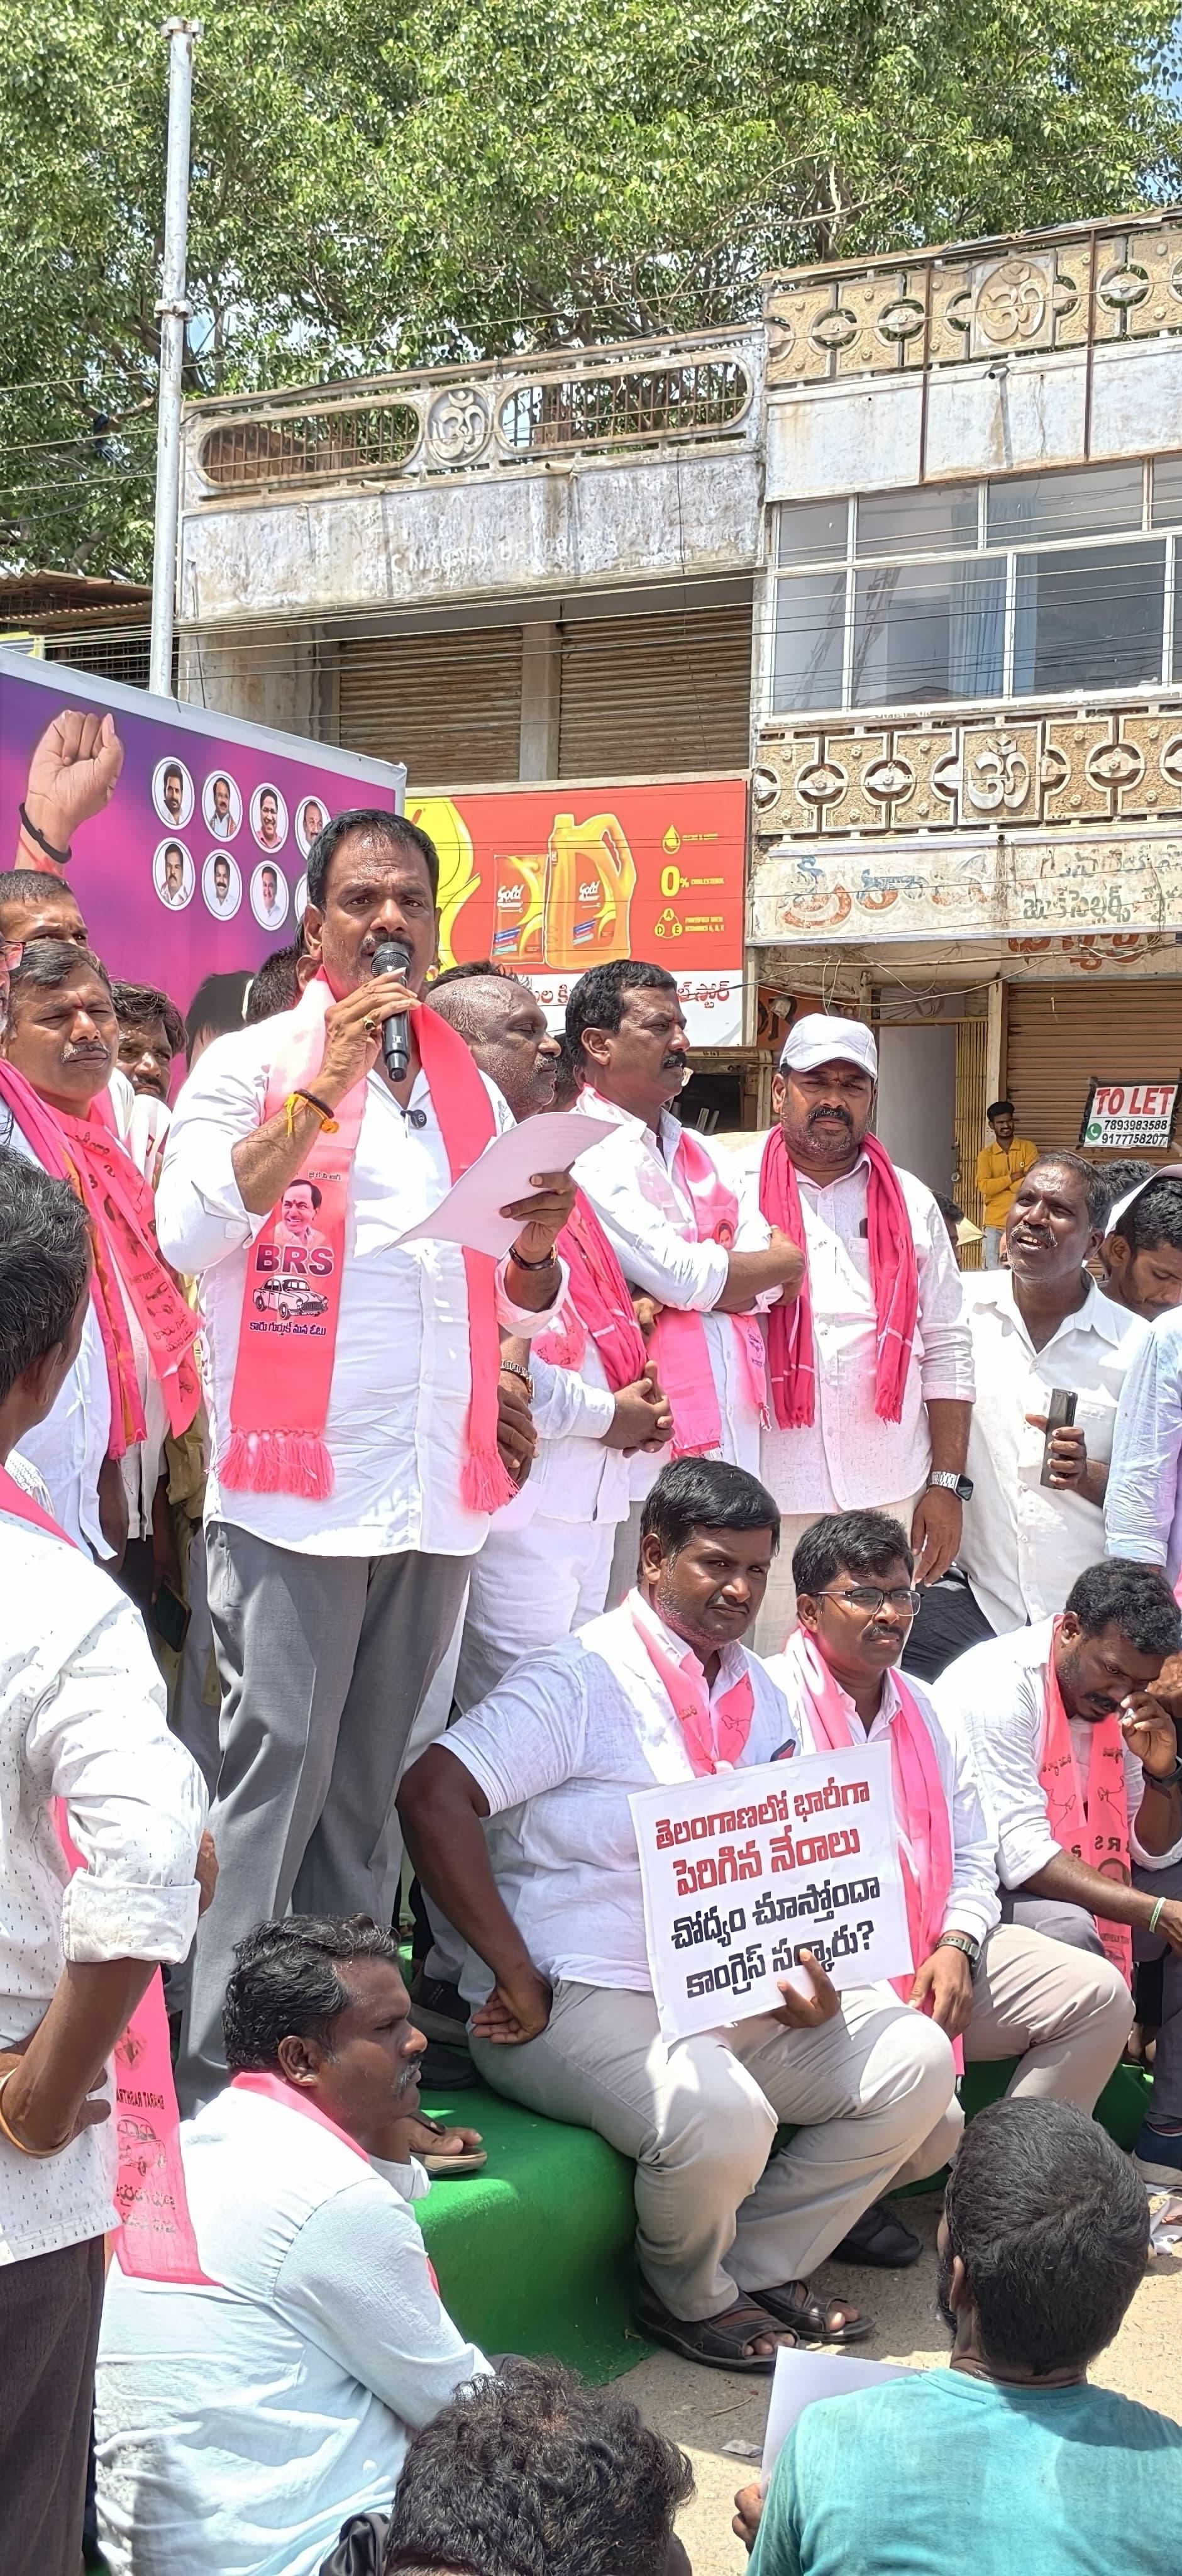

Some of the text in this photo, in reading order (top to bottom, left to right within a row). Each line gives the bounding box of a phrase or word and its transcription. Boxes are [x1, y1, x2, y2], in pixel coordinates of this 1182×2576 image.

[1096, 1087, 1175, 1115] TO LET
[1104, 1119, 1168, 1131] 7893983588
[255, 1244, 334, 1276] BRS
[293, 1324, 308, 1335] మన
[309, 1324, 326, 1336] ఓటు
[655, 1777, 871, 1850] తెలంగాణలో భారీగా
[672, 1824, 861, 1896] పెరిగిన నేరాలు
[671, 1876, 881, 1950] చోద్యం చూస్తోందా
[686, 1943, 766, 1999] కాంగ్రెస్
